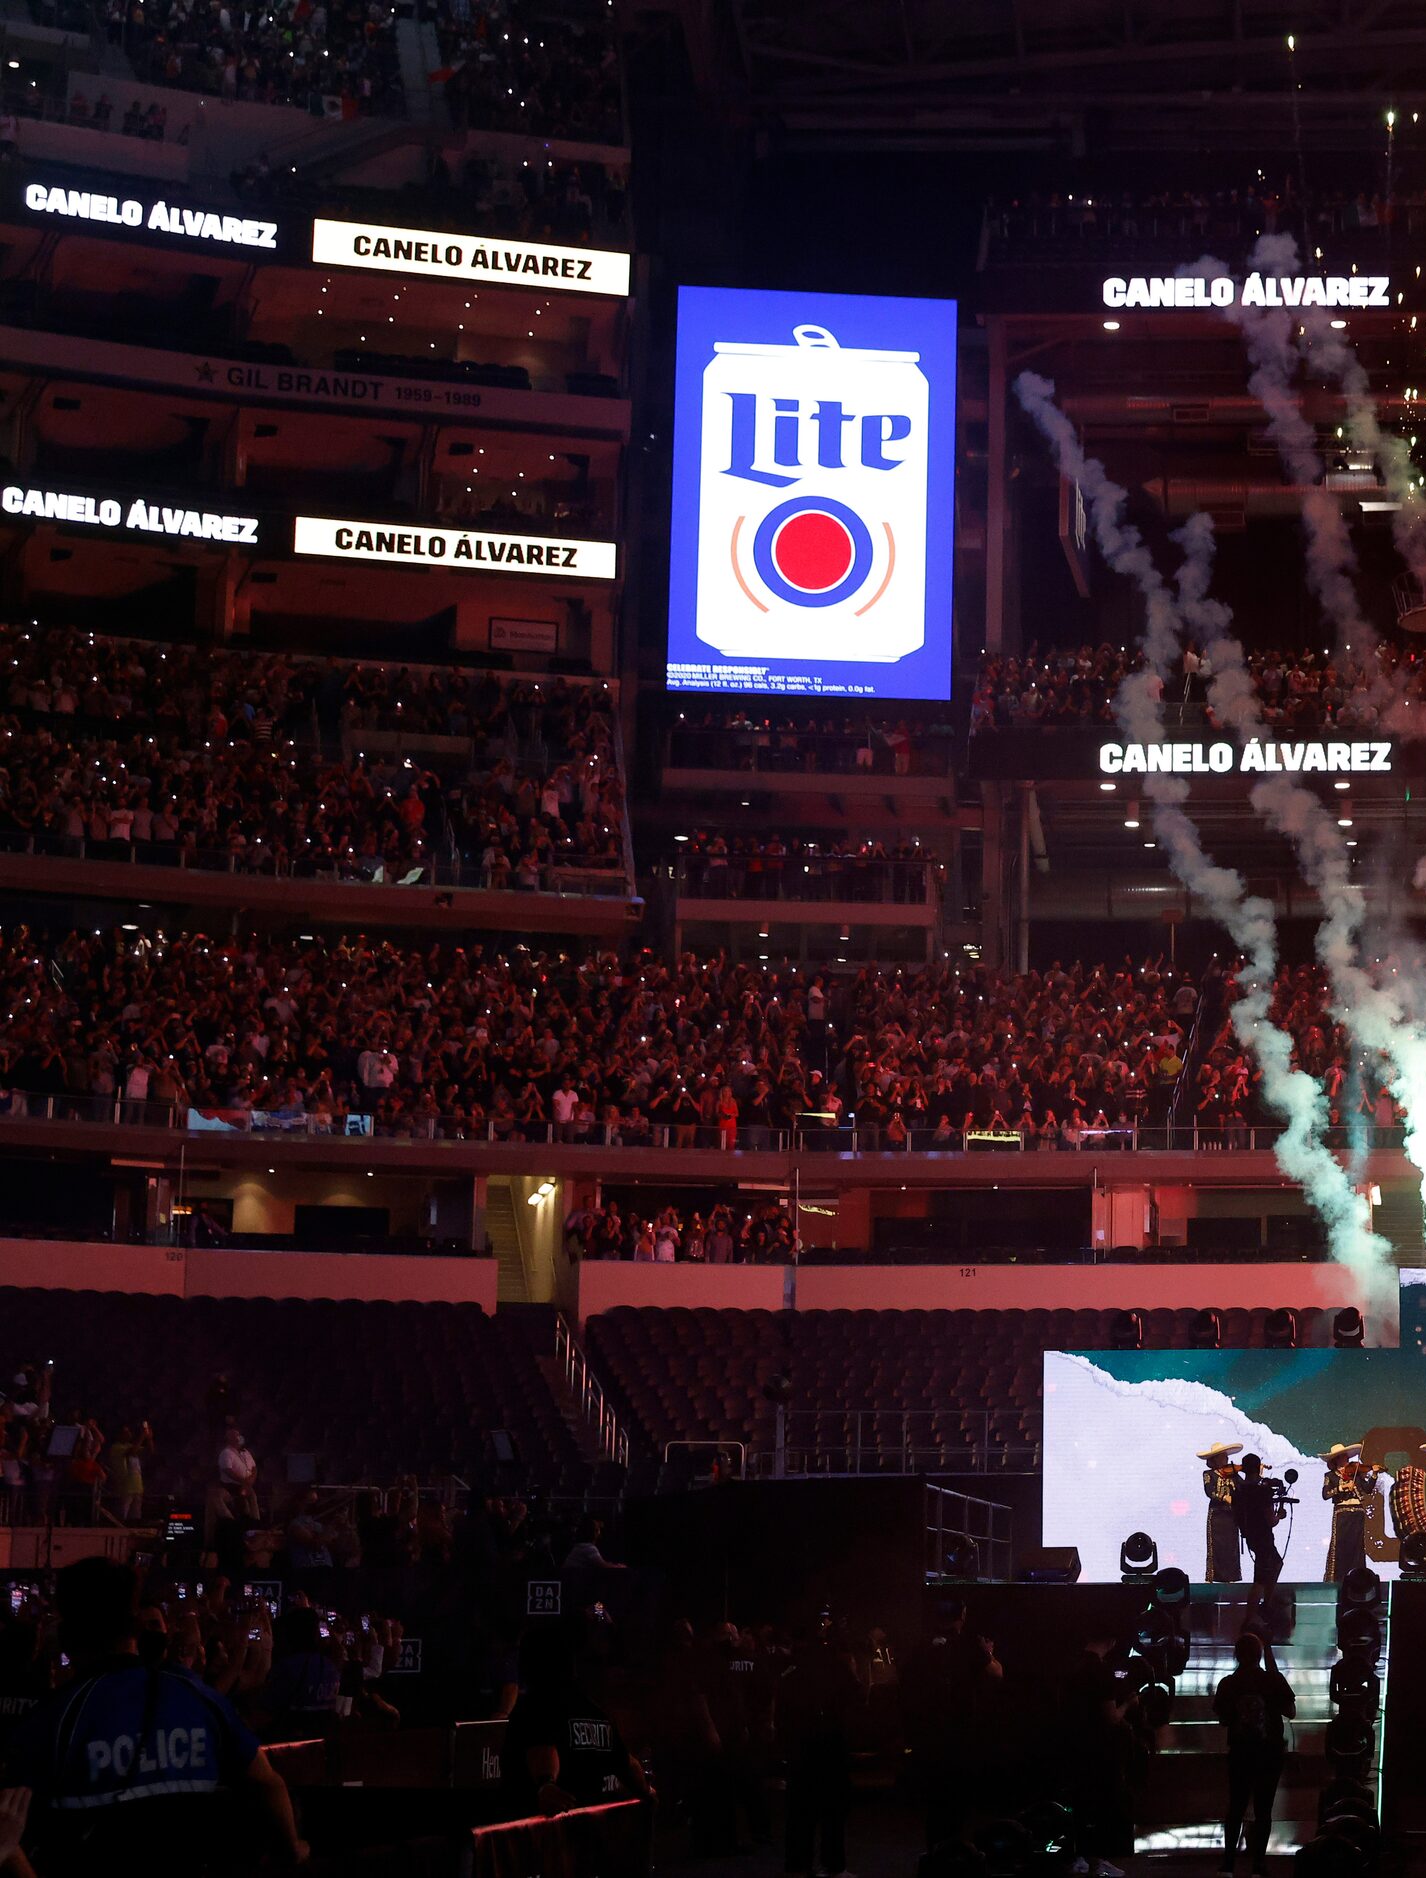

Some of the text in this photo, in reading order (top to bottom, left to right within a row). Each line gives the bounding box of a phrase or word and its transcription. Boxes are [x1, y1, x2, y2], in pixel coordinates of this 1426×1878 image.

[26, 184, 278, 249] CANELO ÁLVAREZ
[354, 236, 592, 281] CANELO ÁLVAREZ
[1102, 271, 1390, 308] CANELO ÁLVAREZ
[227, 367, 269, 389] GIL
[277, 373, 384, 400] BRANDT
[718, 392, 912, 489] Lite
[1, 487, 259, 545] CANELO ÁLVAREZ
[335, 528, 578, 568] CANELO ÁLVAREZ
[1099, 737, 1392, 774] CANELO ÁLVAREZ
[959, 1267, 977, 1278] 121
[86, 1727, 207, 1784] POLICE
